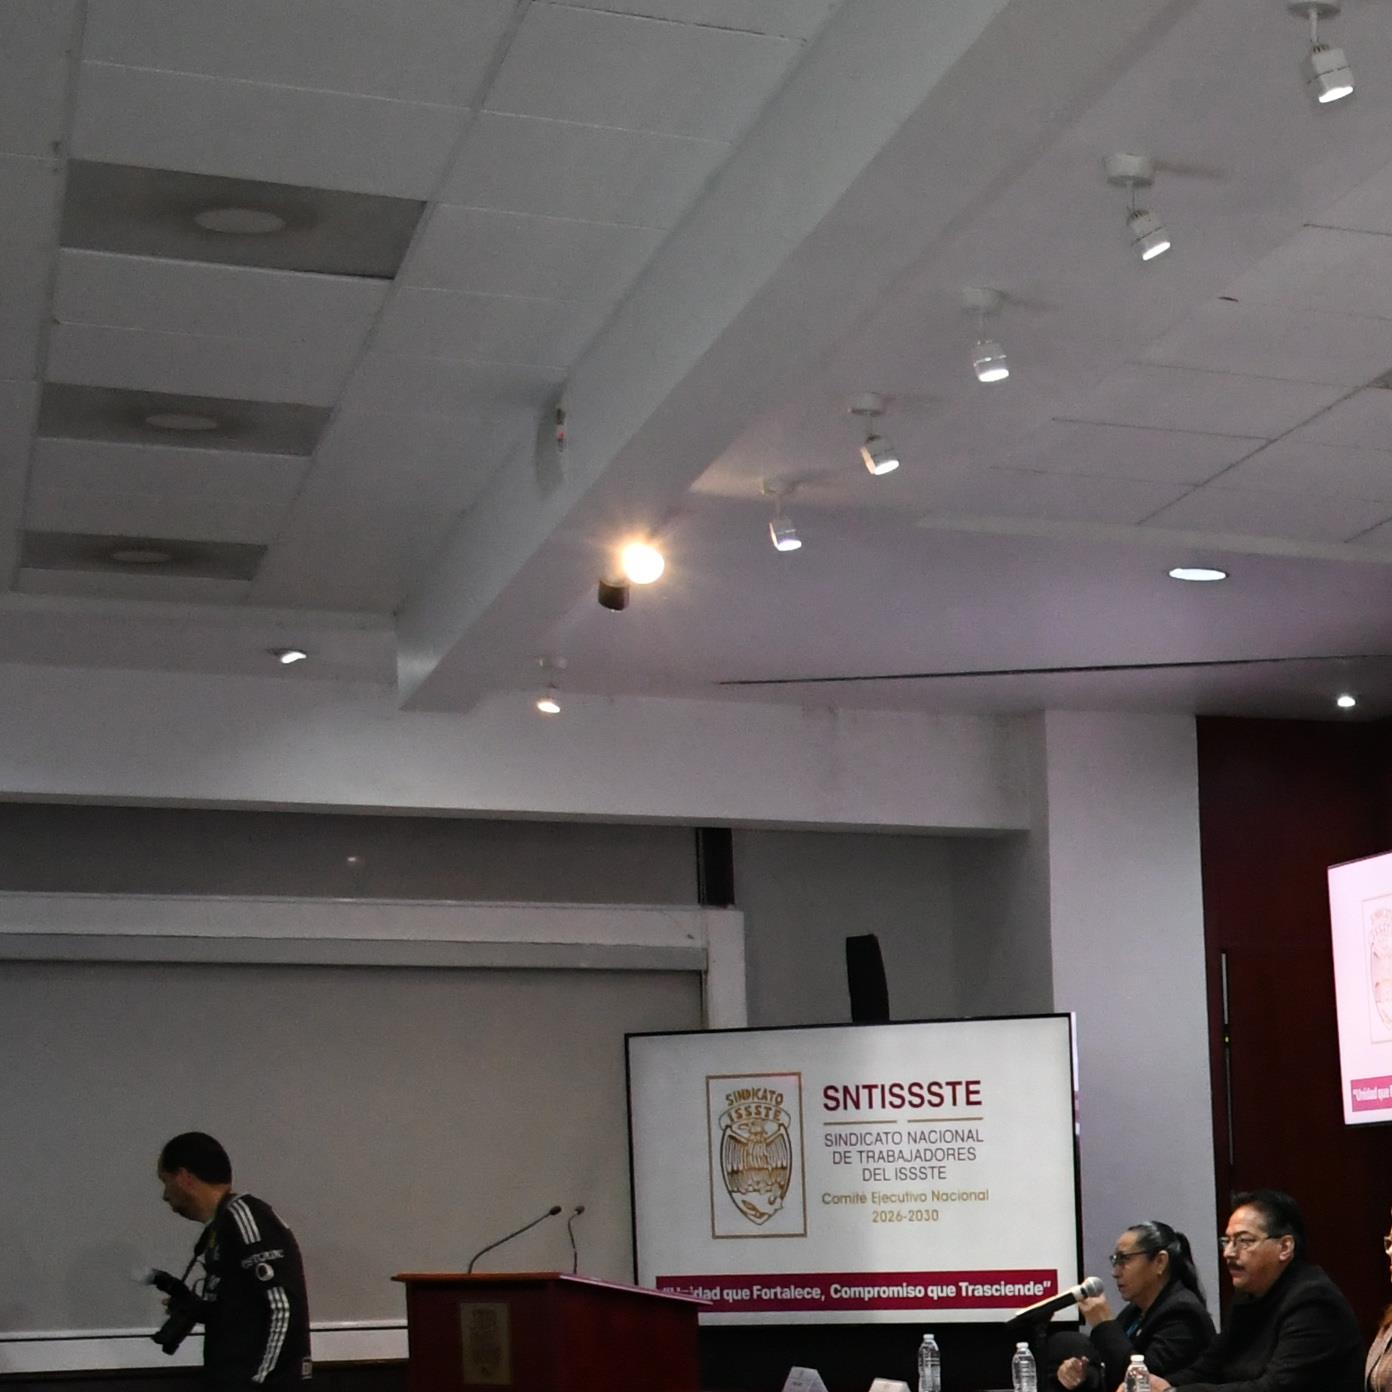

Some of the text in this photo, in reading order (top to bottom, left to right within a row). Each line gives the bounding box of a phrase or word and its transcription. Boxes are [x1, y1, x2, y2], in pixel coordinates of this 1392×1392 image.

[725, 1087, 784, 1106] SINDICATO
[823, 1080, 983, 1111] SNTISSSTE
[728, 1104, 781, 1122] ISSSTE
[824, 1129, 984, 1147] SINDICATO NACIONAL
[832, 1147, 976, 1165] DE TRABAJADORES
[862, 1166, 947, 1182] DEL ISSSTE
[822, 1189, 989, 1206] Comité Ejecutivo Nacional
[872, 1209, 939, 1223] 2026-2030
[723, 1287, 751, 1302] que
[752, 1285, 825, 1302] Fortalece,
[830, 1283, 925, 1301] Compromiso
[927, 1285, 956, 1300] que
[958, 1281, 1051, 1297] Trasciende"
